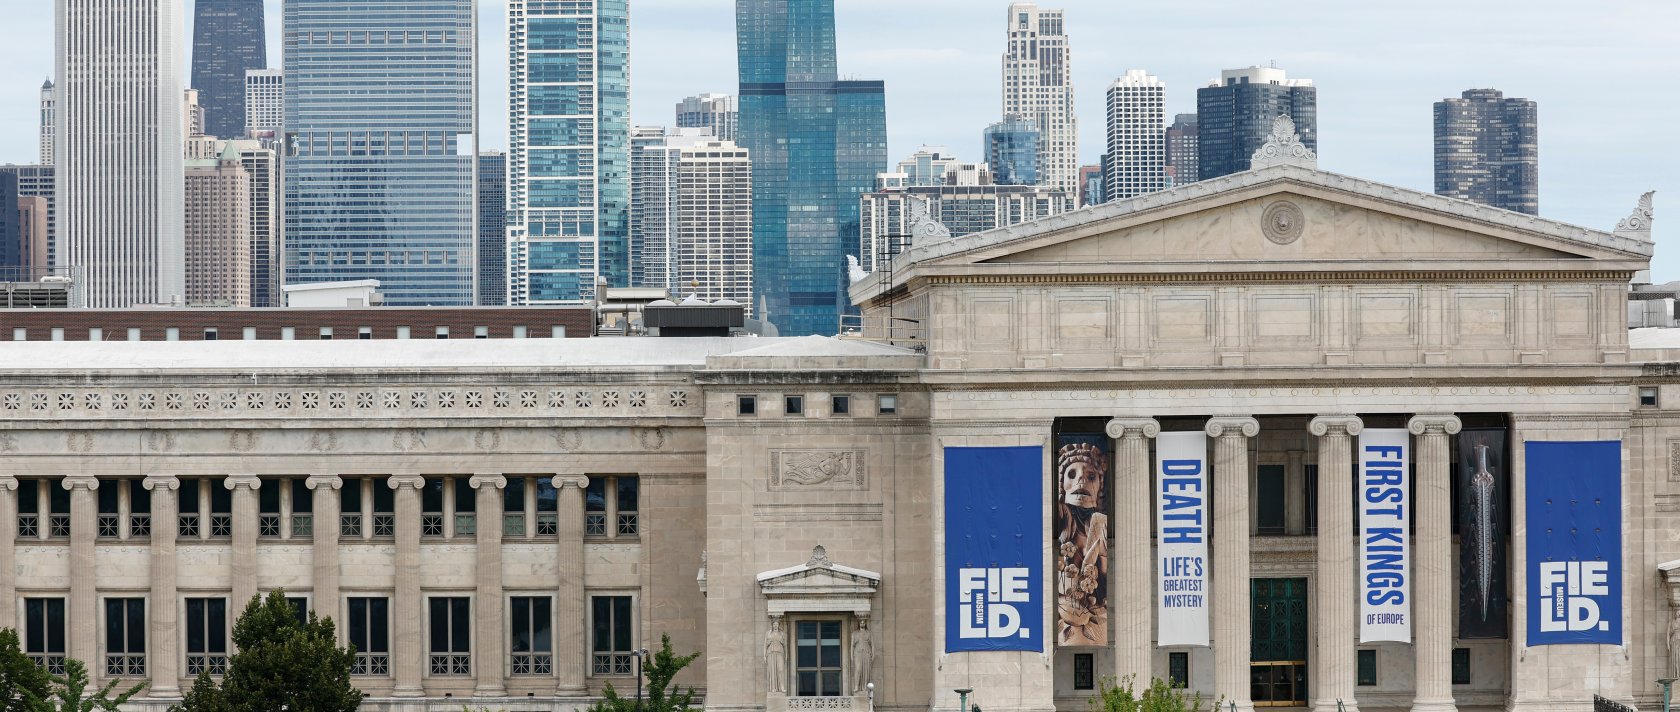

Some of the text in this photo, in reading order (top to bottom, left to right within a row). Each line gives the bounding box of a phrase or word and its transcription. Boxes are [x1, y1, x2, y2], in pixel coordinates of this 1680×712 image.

[1162, 459, 1202, 543] DEATH
[1365, 445, 1404, 606] FIRST KINGS
[1163, 556, 1203, 577] LIFE'S
[1540, 560, 1609, 597] FIE
[959, 567, 1030, 603] FIE
[1163, 579, 1203, 592] GREATEST
[1164, 594, 1203, 608] MYSTERY
[975, 592, 984, 625] MUSEUM
[1556, 586, 1565, 618] MUSEUM
[1366, 613, 1405, 625] OF EUROPE
